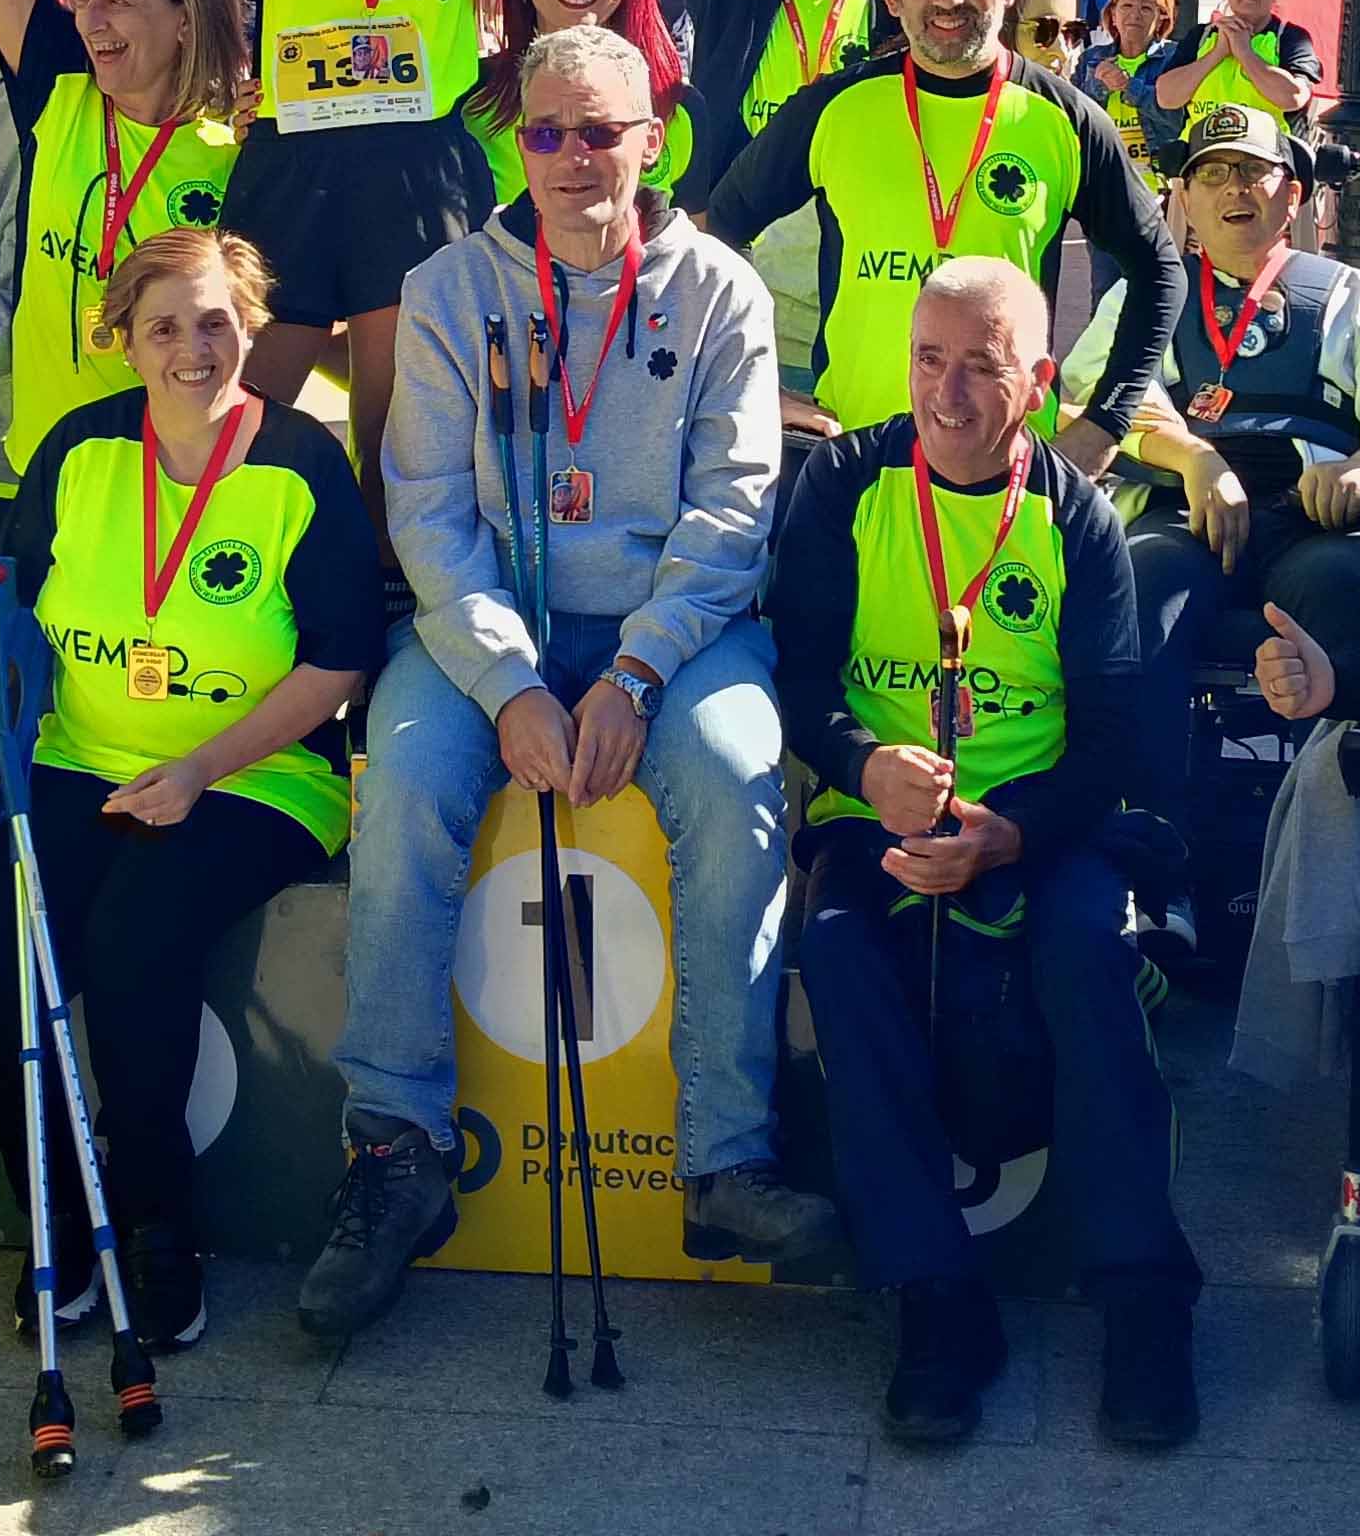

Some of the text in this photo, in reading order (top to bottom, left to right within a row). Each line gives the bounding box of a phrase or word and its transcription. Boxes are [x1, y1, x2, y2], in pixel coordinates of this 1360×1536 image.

[307, 53, 419, 91] 136
[857, 251, 955, 282] AVEM
[850, 656, 1001, 694] AVEMO
[1228, 902, 1255, 916] QUI
[521, 1124, 675, 1160] Deputac
[521, 1160, 686, 1192] Ponteve
